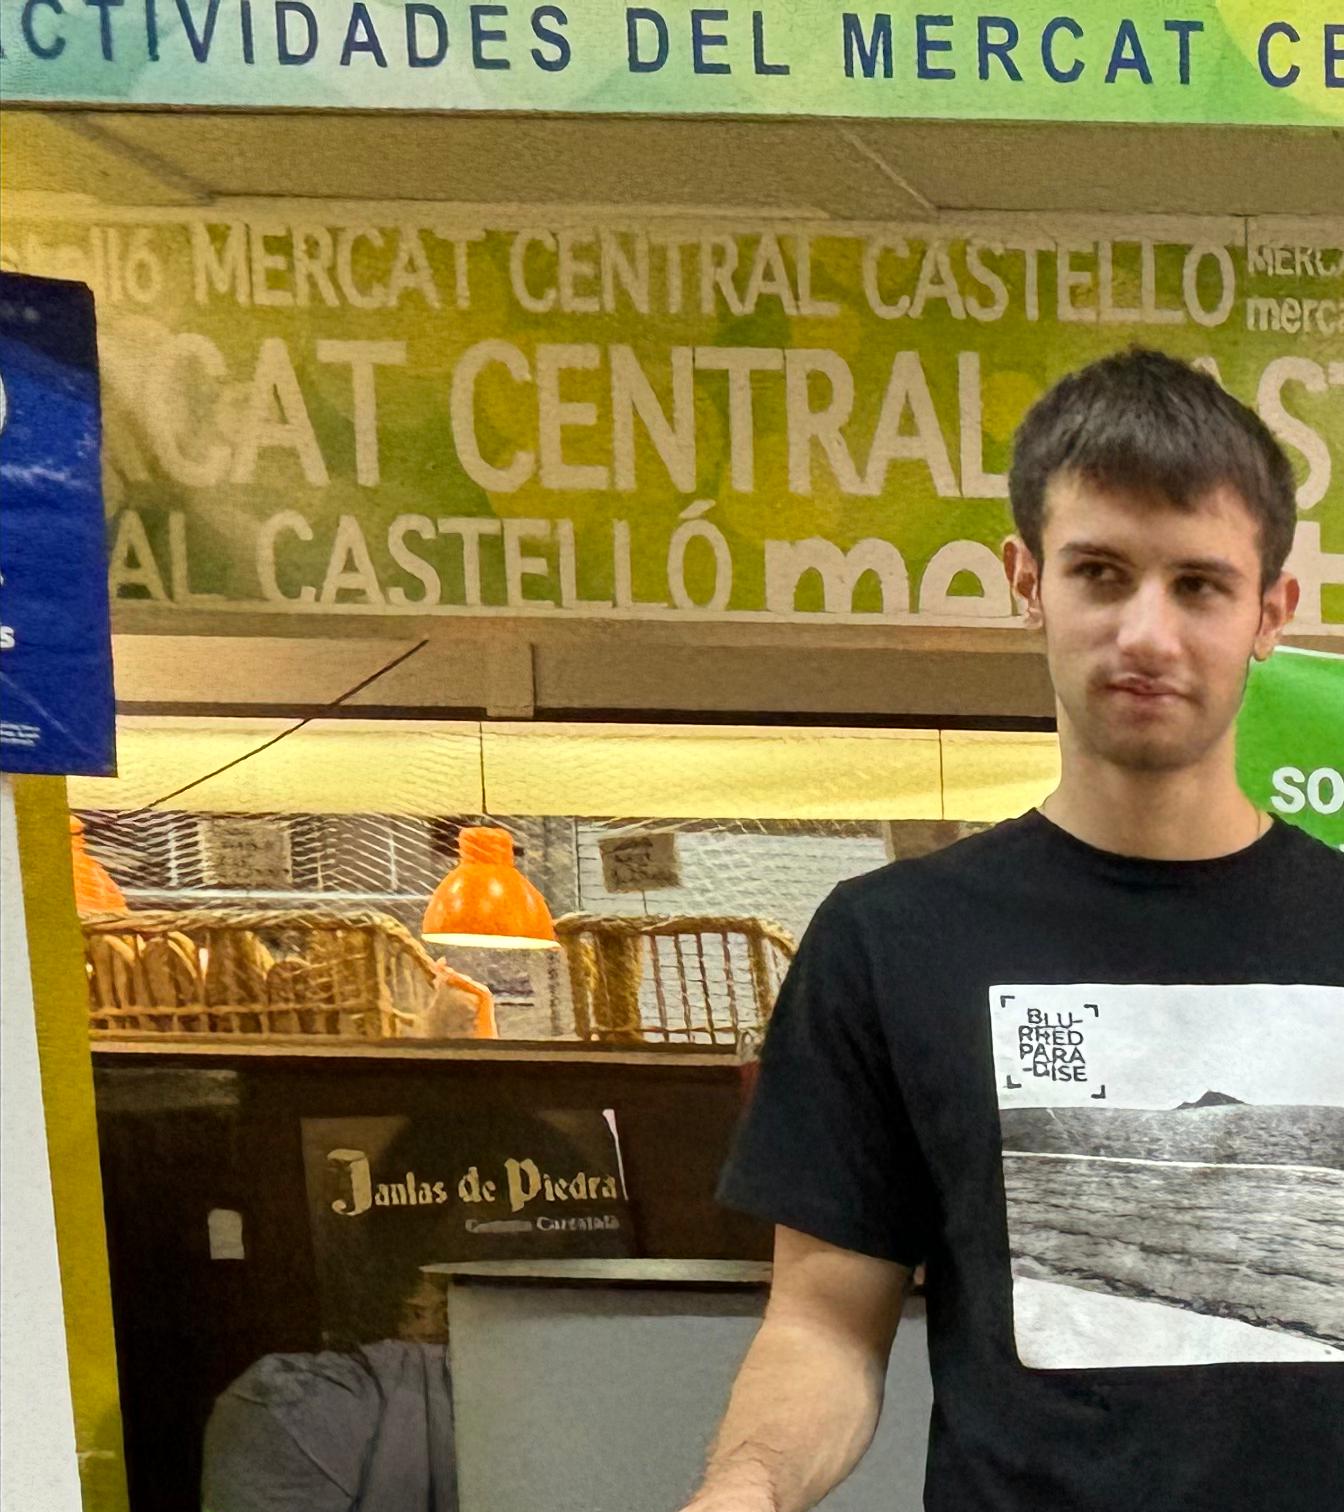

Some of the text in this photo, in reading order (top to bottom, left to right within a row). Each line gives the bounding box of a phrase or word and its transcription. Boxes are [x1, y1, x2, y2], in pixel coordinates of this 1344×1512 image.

[0, 0, 573, 74] CTIVIDADES
[626, 6, 791, 78] DEL
[842, 12, 1206, 86] MERCAT
[190, 221, 485, 310] MERCAT
[509, 229, 838, 317] CENTRAL
[451, 340, 1009, 498] CENTRAL
[256, 500, 733, 611] CASTELLÓ
[1019, 1043, 1086, 1064] PARA
[458, 1166, 496, 1203] de
